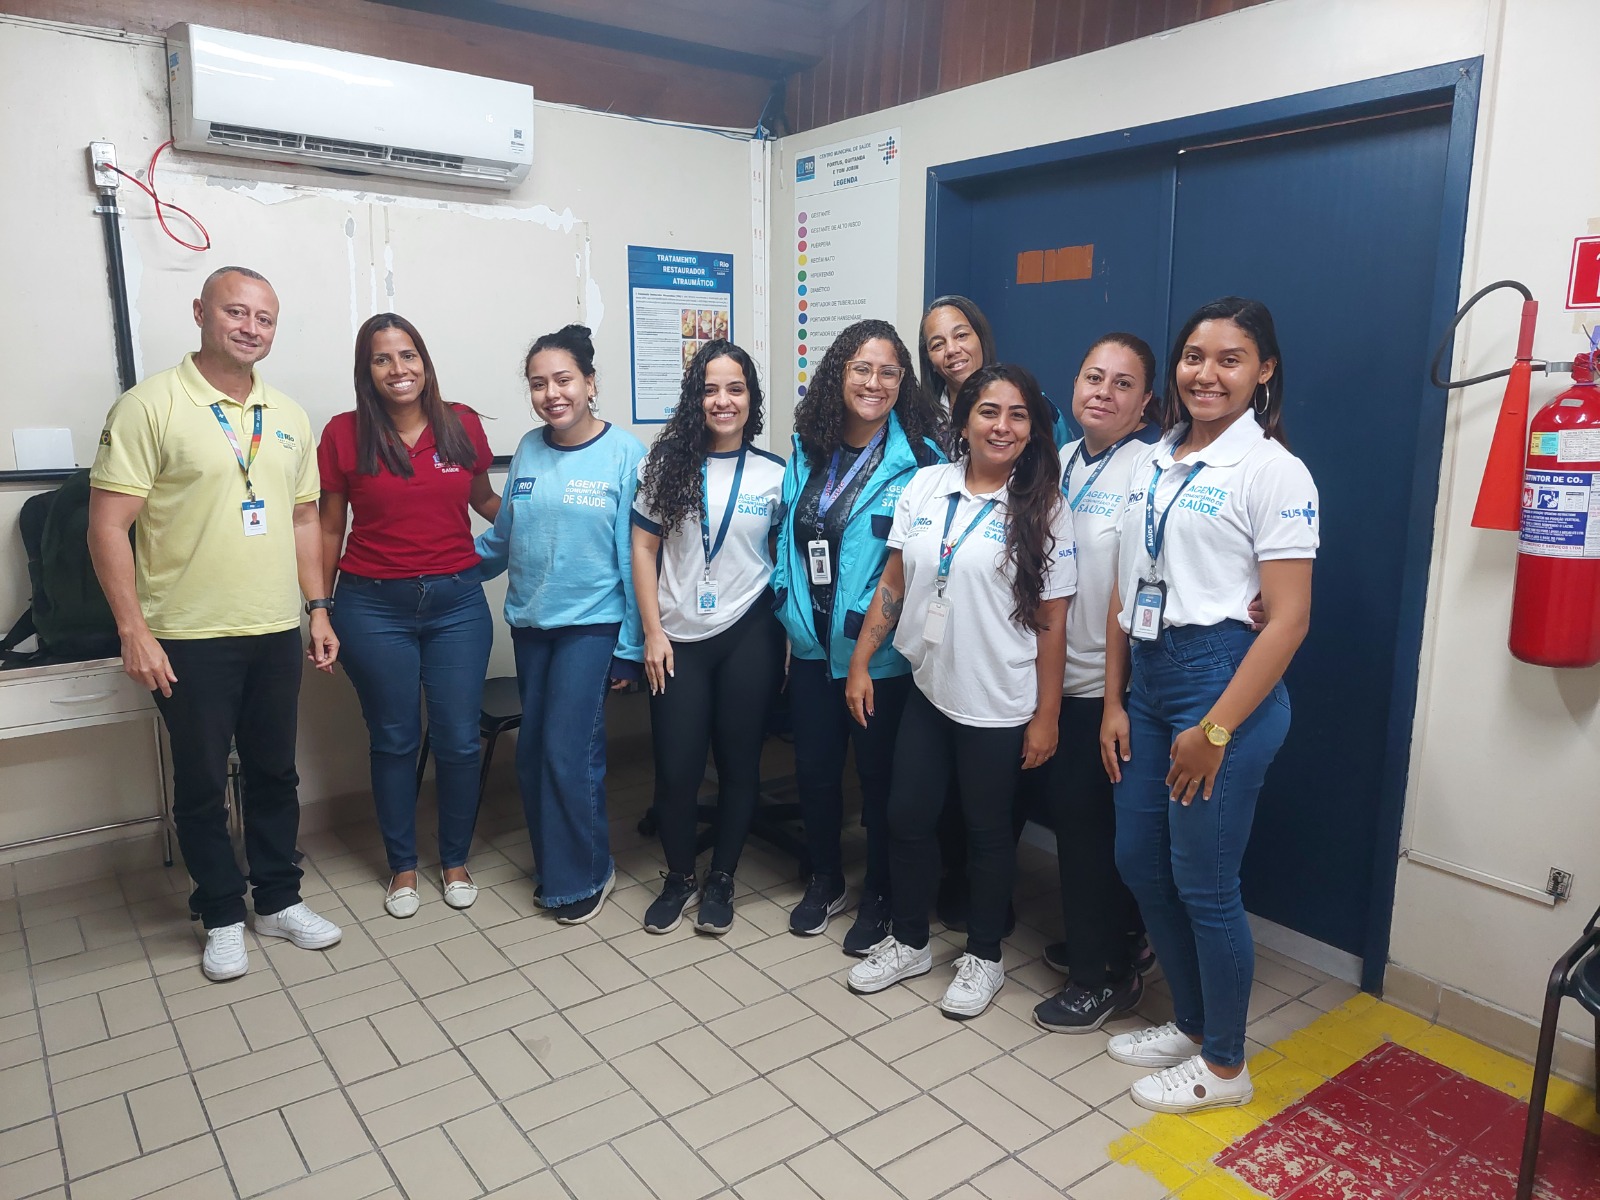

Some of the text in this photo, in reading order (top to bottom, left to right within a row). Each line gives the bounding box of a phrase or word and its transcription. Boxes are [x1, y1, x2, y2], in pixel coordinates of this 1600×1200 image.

[819, 152, 833, 160] CENTRO
[834, 147, 852, 157] MUNICIPAL
[845, 155, 866, 164] QUITANDA
[805, 161, 814, 171] RIO
[833, 176, 858, 187] LEGENDA
[811, 210, 831, 219] GESTANTE
[811, 225, 831, 234] GESTANTE
[848, 221, 862, 229] RISCO
[657, 254, 697, 264] TRATAMENTO
[719, 260, 730, 268] Rio
[663, 266, 706, 275] RESTAURADOR
[672, 277, 714, 287] ATRAUMÁTICO
[810, 315, 831, 323] PORTADOR
[810, 330, 831, 338] PORTADOR
[284, 433, 295, 442] Rio
[441, 466, 460, 474] SAÚDE
[518, 481, 533, 490] RIO
[567, 479, 610, 491] AGENTE
[565, 487, 607, 496] COMUNITÁRIO
[1085, 490, 1123, 503] AGENTE
[1187, 485, 1228, 501] AGENTE
[563, 493, 606, 508] DE SAÚDE
[738, 493, 769, 503] AGENTE
[1128, 491, 1144, 504] RIO
[1182, 492, 1215, 504] COMUNITÁRIO
[738, 503, 768, 517] SAÚDE
[1077, 503, 1115, 518] SAÚDE
[1178, 497, 1220, 517] SAÚDE
[1280, 509, 1301, 519] SUS
[918, 517, 932, 526] Rio
[1146, 524, 1154, 547] SAÚDE
[1058, 549, 1073, 558] SUS
[1083, 988, 1113, 1012] FILA
